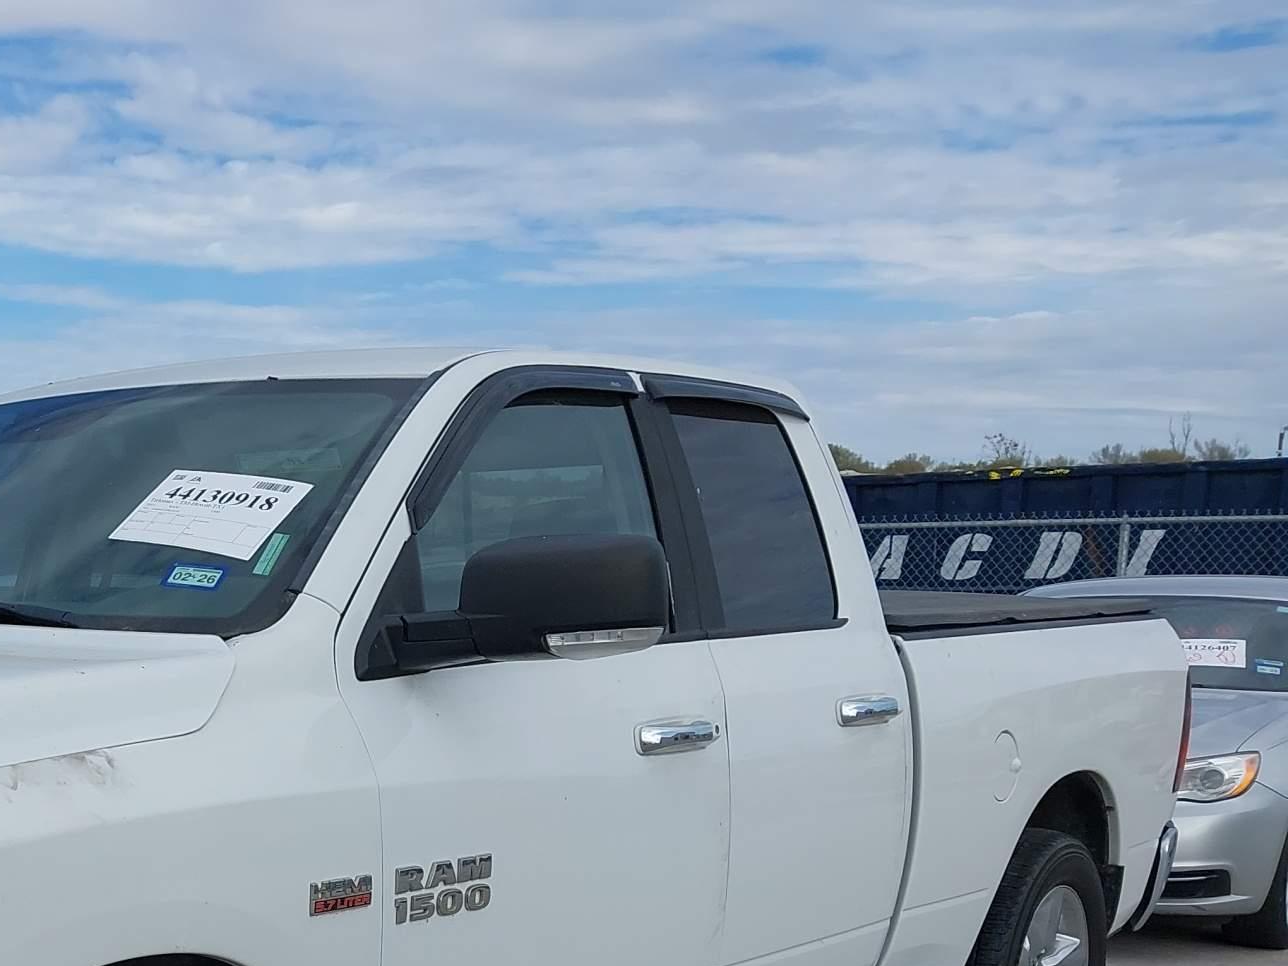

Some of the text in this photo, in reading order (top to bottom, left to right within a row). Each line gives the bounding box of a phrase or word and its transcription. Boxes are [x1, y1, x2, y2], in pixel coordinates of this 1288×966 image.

[165, 486, 279, 511] 44130918
[172, 571, 218, 584] 02 26
[395, 852, 493, 895] RAM
[336, 894, 370, 910] LITER
[394, 884, 492, 926] 1500
